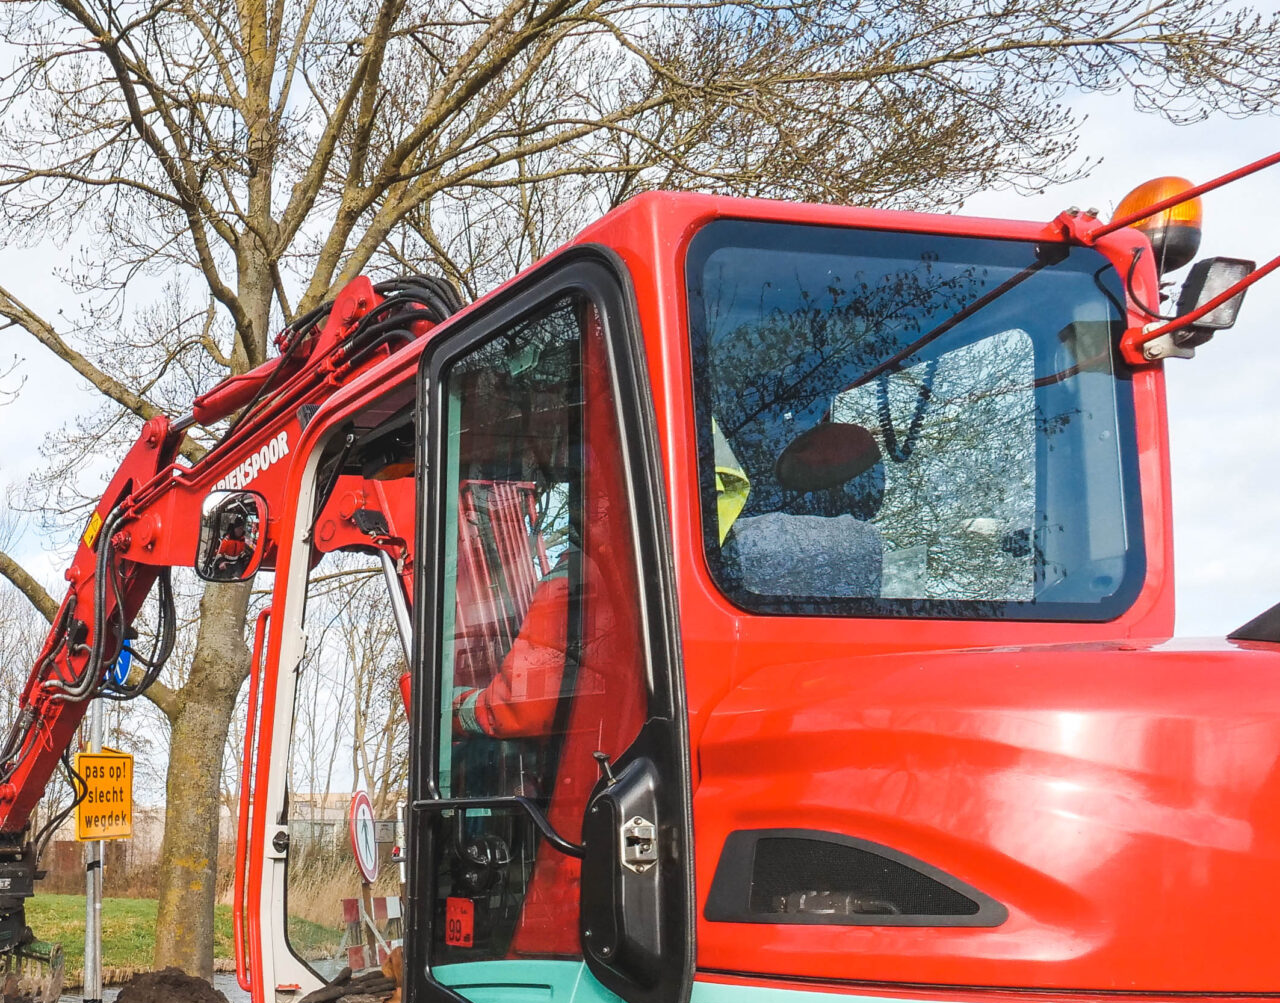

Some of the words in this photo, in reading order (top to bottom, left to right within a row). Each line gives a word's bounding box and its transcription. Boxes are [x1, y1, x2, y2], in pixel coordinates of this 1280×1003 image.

[210, 430, 289, 493] IEKSPOOR
[85, 766, 105, 781] pas
[109, 761, 126, 781] op!
[88, 786, 124, 803] slecht
[85, 810, 127, 832] wegdek
